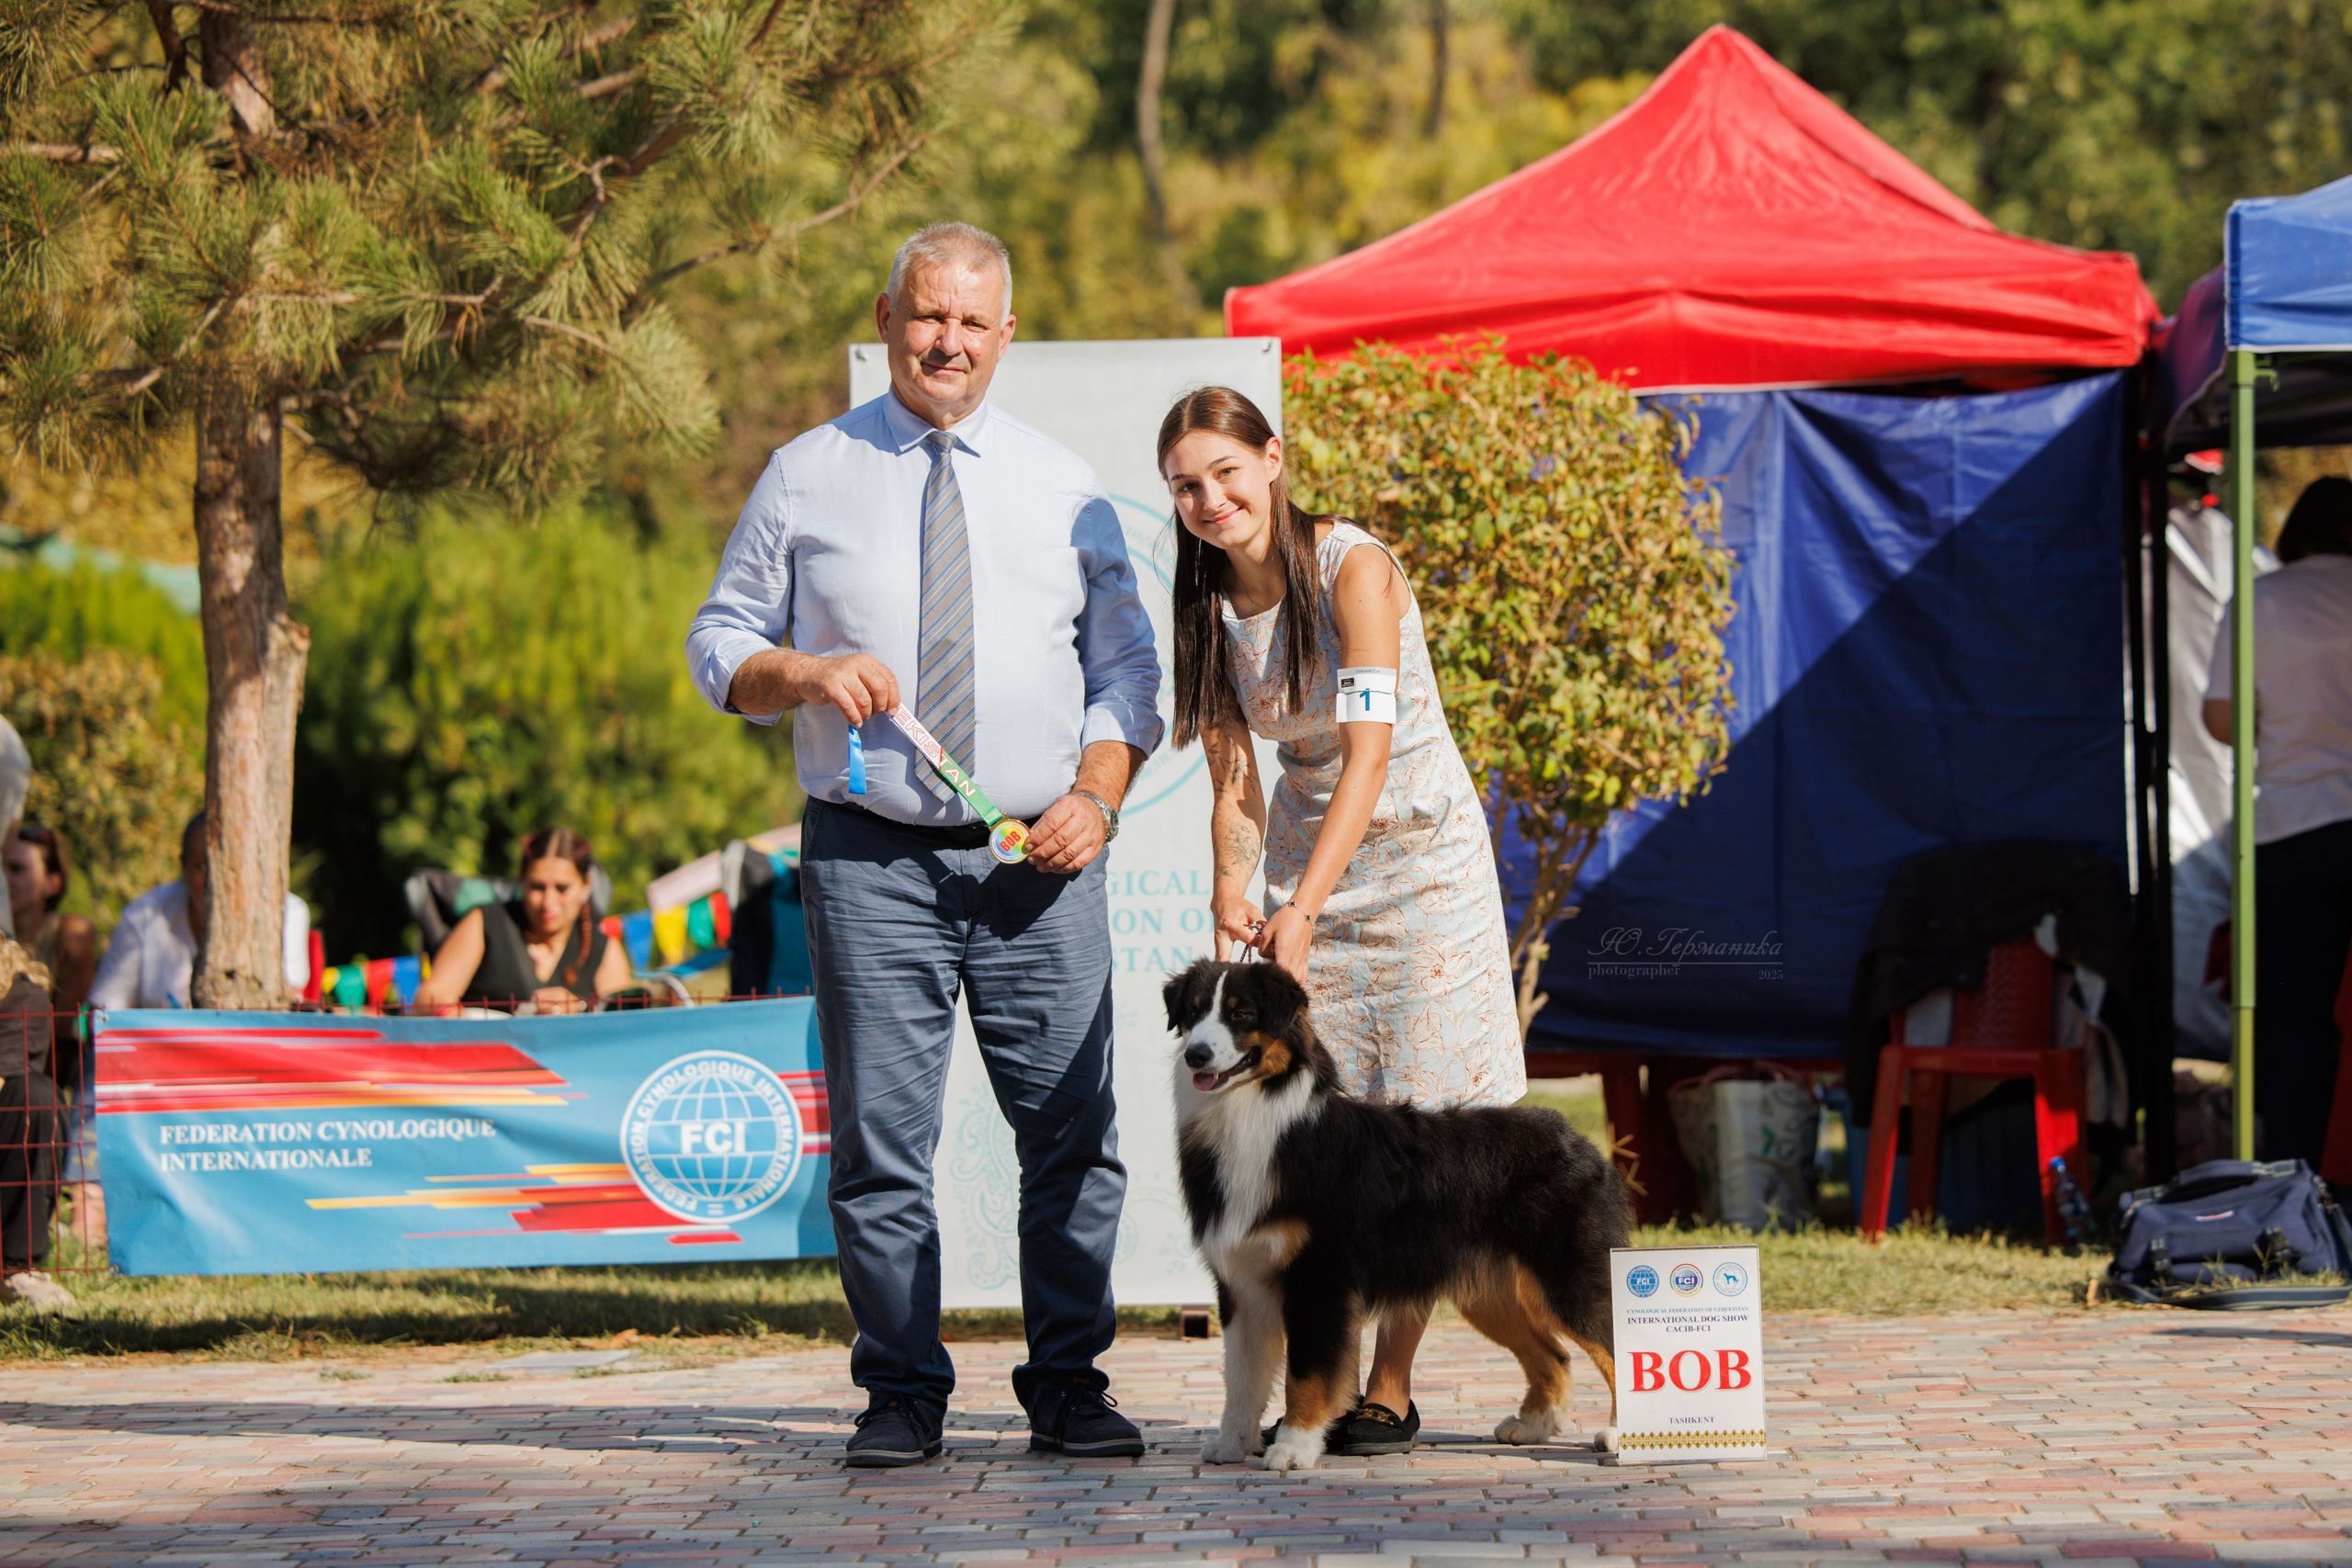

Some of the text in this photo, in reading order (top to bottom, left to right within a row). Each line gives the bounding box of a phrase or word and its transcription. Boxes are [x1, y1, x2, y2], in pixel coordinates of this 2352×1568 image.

[1360, 688, 1370, 711] 1
[999, 830, 1022, 852] BOB
[1179, 908, 1215, 934] O
[159, 1118, 497, 1145] FEDERATION CYNOLOGIQUE
[630, 1060, 794, 1212] FEDERATION CYNOLOGIQUE INTERNATIONALE
[681, 1122, 746, 1154] FCI
[159, 1147, 373, 1172] INTERNATIONALE
[1678, 1277, 1695, 1285] FCI
[1627, 1316, 1700, 1325] INTERNATIONAL
[1666, 1325, 1711, 1333] CACIB-FCI
[1627, 1349, 1752, 1393] BOB
